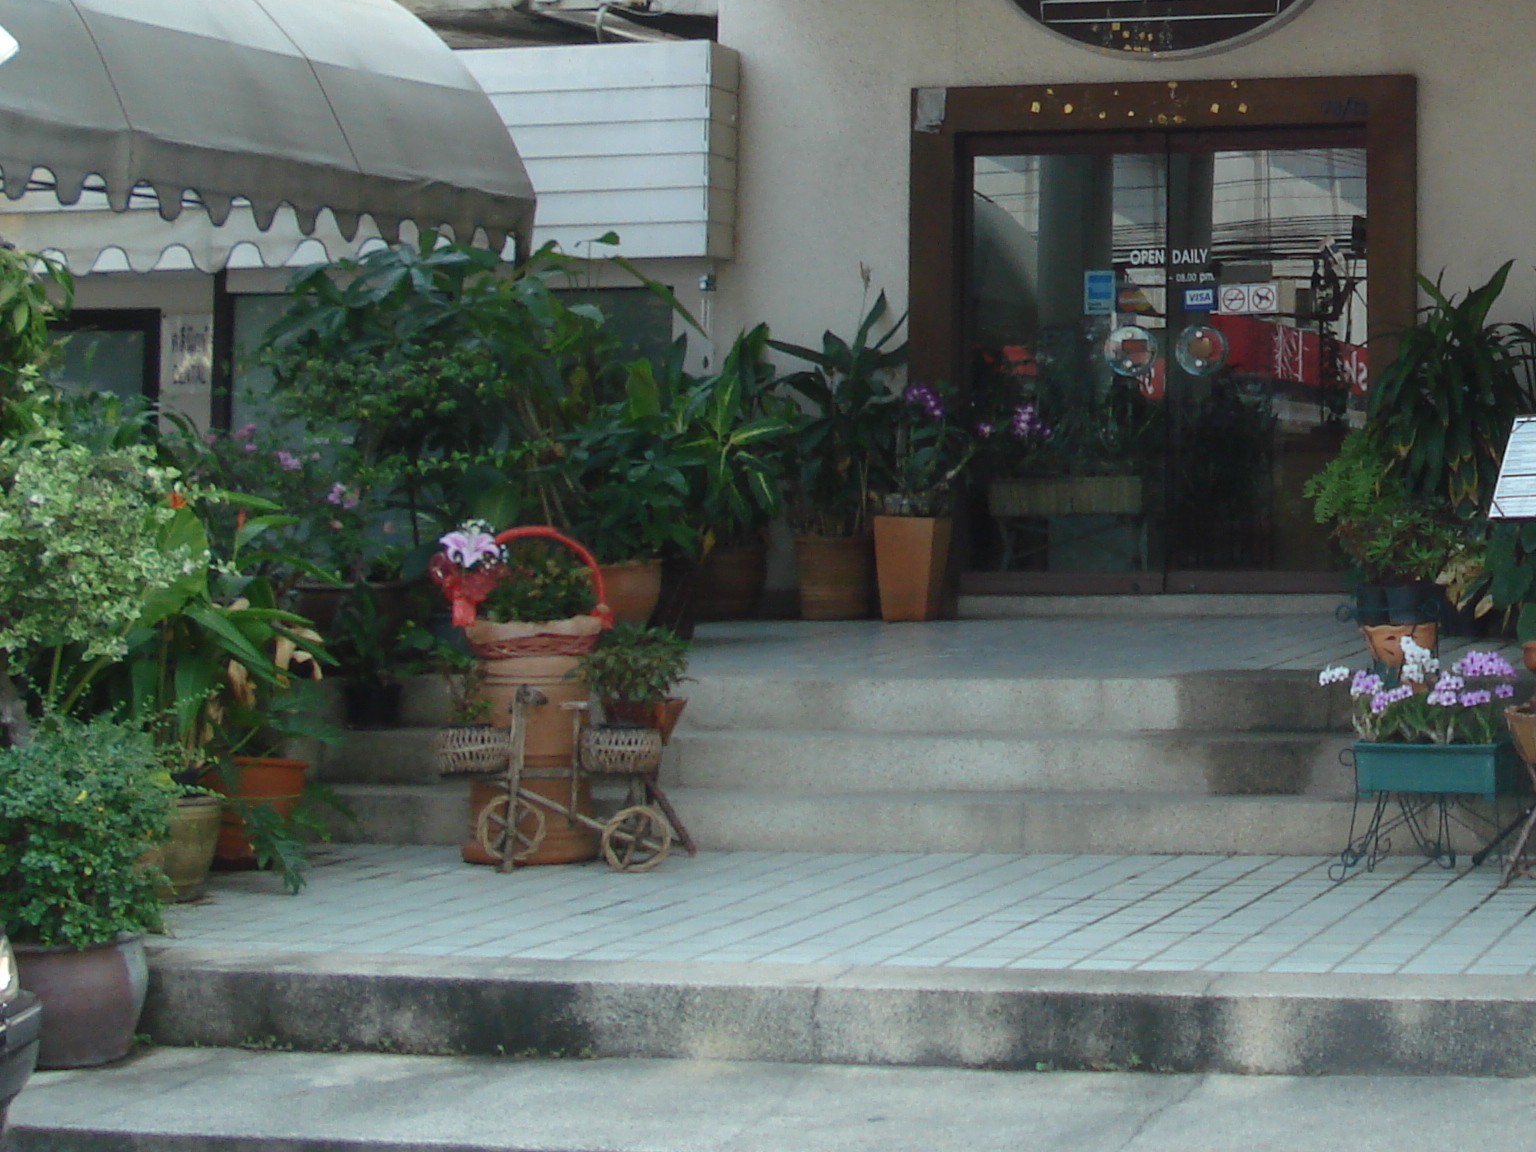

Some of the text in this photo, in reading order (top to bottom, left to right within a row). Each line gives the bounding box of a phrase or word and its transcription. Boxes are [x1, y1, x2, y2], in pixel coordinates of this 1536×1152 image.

[1130, 249, 1208, 265] OPEN DAILY
[1188, 292, 1211, 302] VISA
